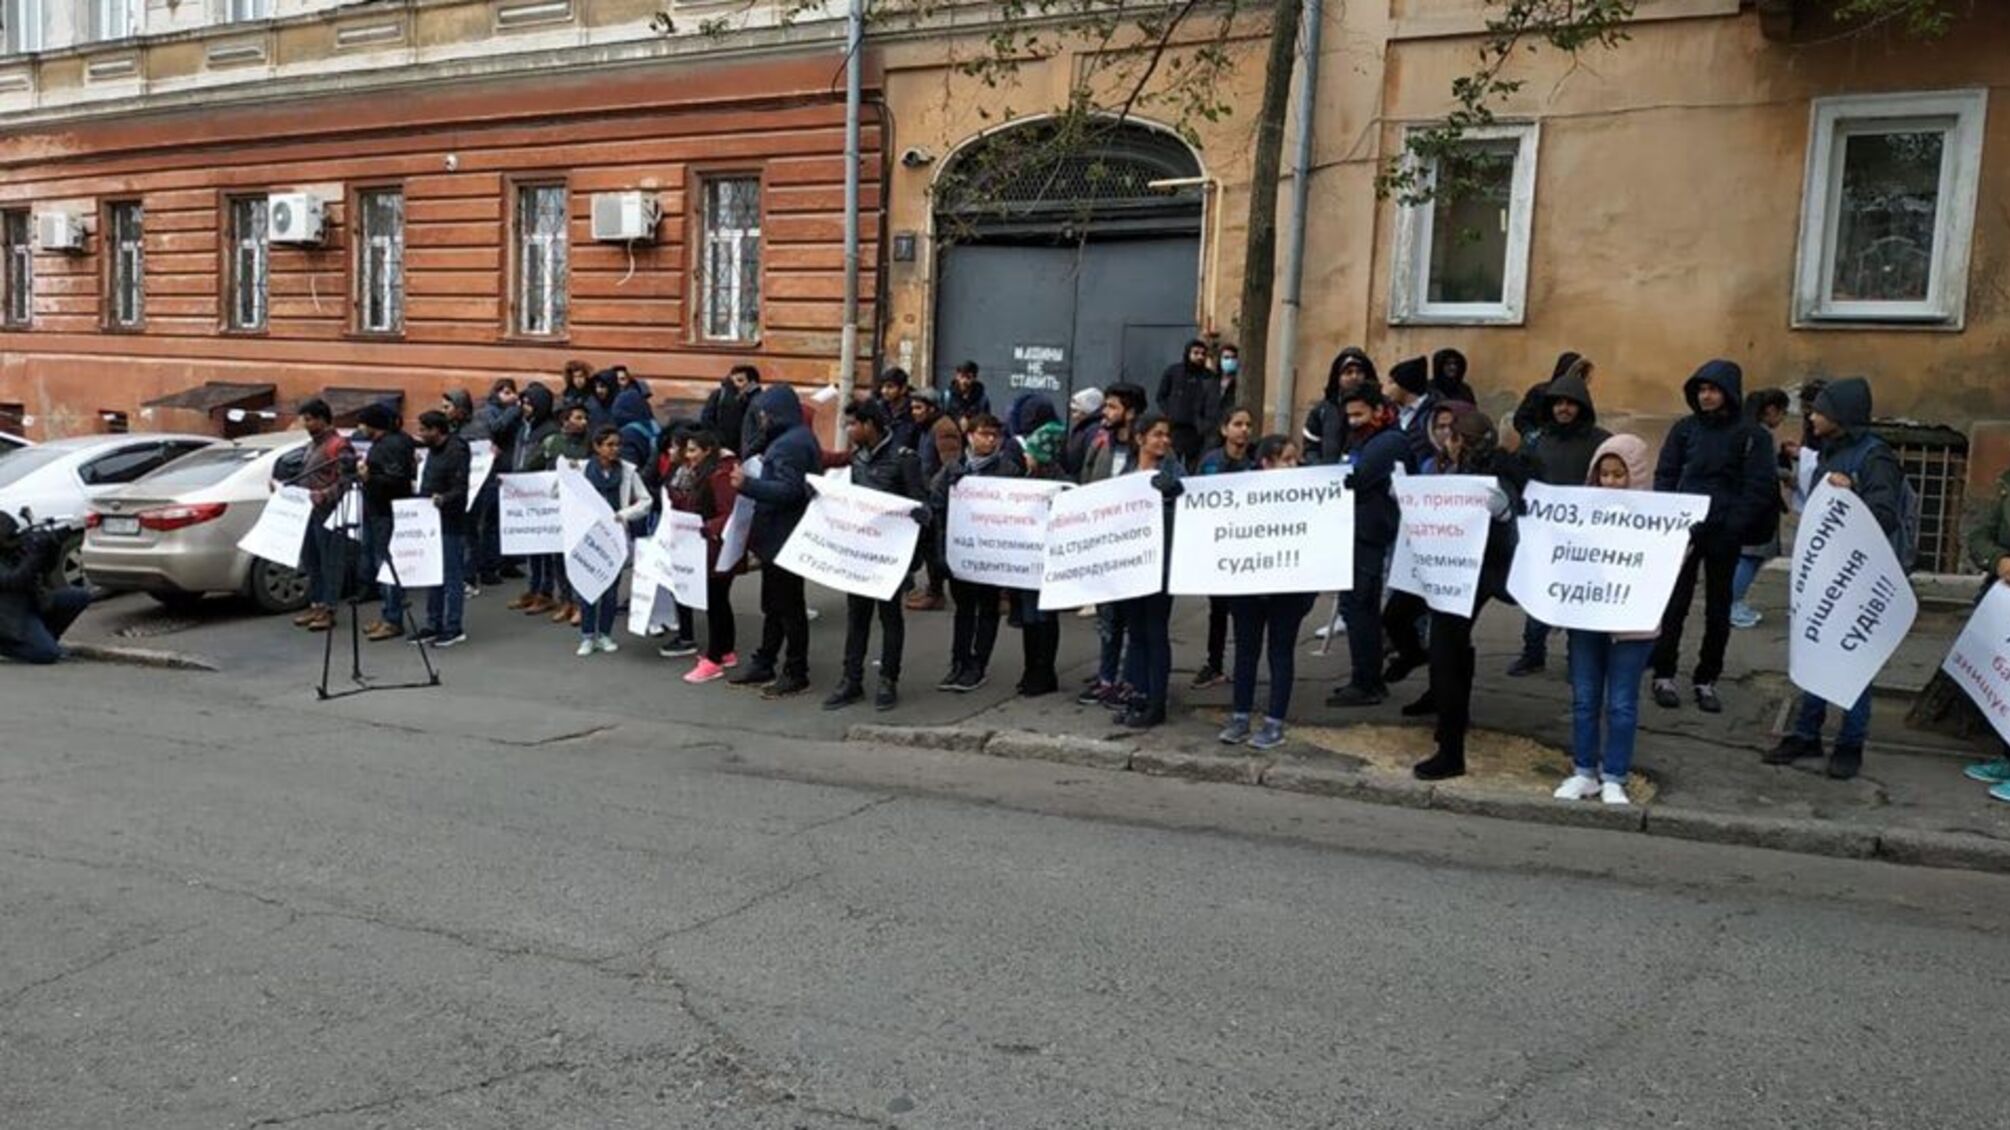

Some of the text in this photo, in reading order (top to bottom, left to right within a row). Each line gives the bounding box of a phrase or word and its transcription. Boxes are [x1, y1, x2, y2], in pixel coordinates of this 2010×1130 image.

[1185, 480, 1342, 510] МОЗ, виконуй
[1214, 521, 1308, 543] рішення
[1527, 499, 1692, 537] МОЗ, виконуй
[1217, 549, 1300, 576] судів!!!
[1551, 540, 1645, 569] рішення
[1547, 581, 1632, 605] судів!!!
[1804, 548, 1870, 645] рішення
[1839, 574, 1898, 653] судів!!!
